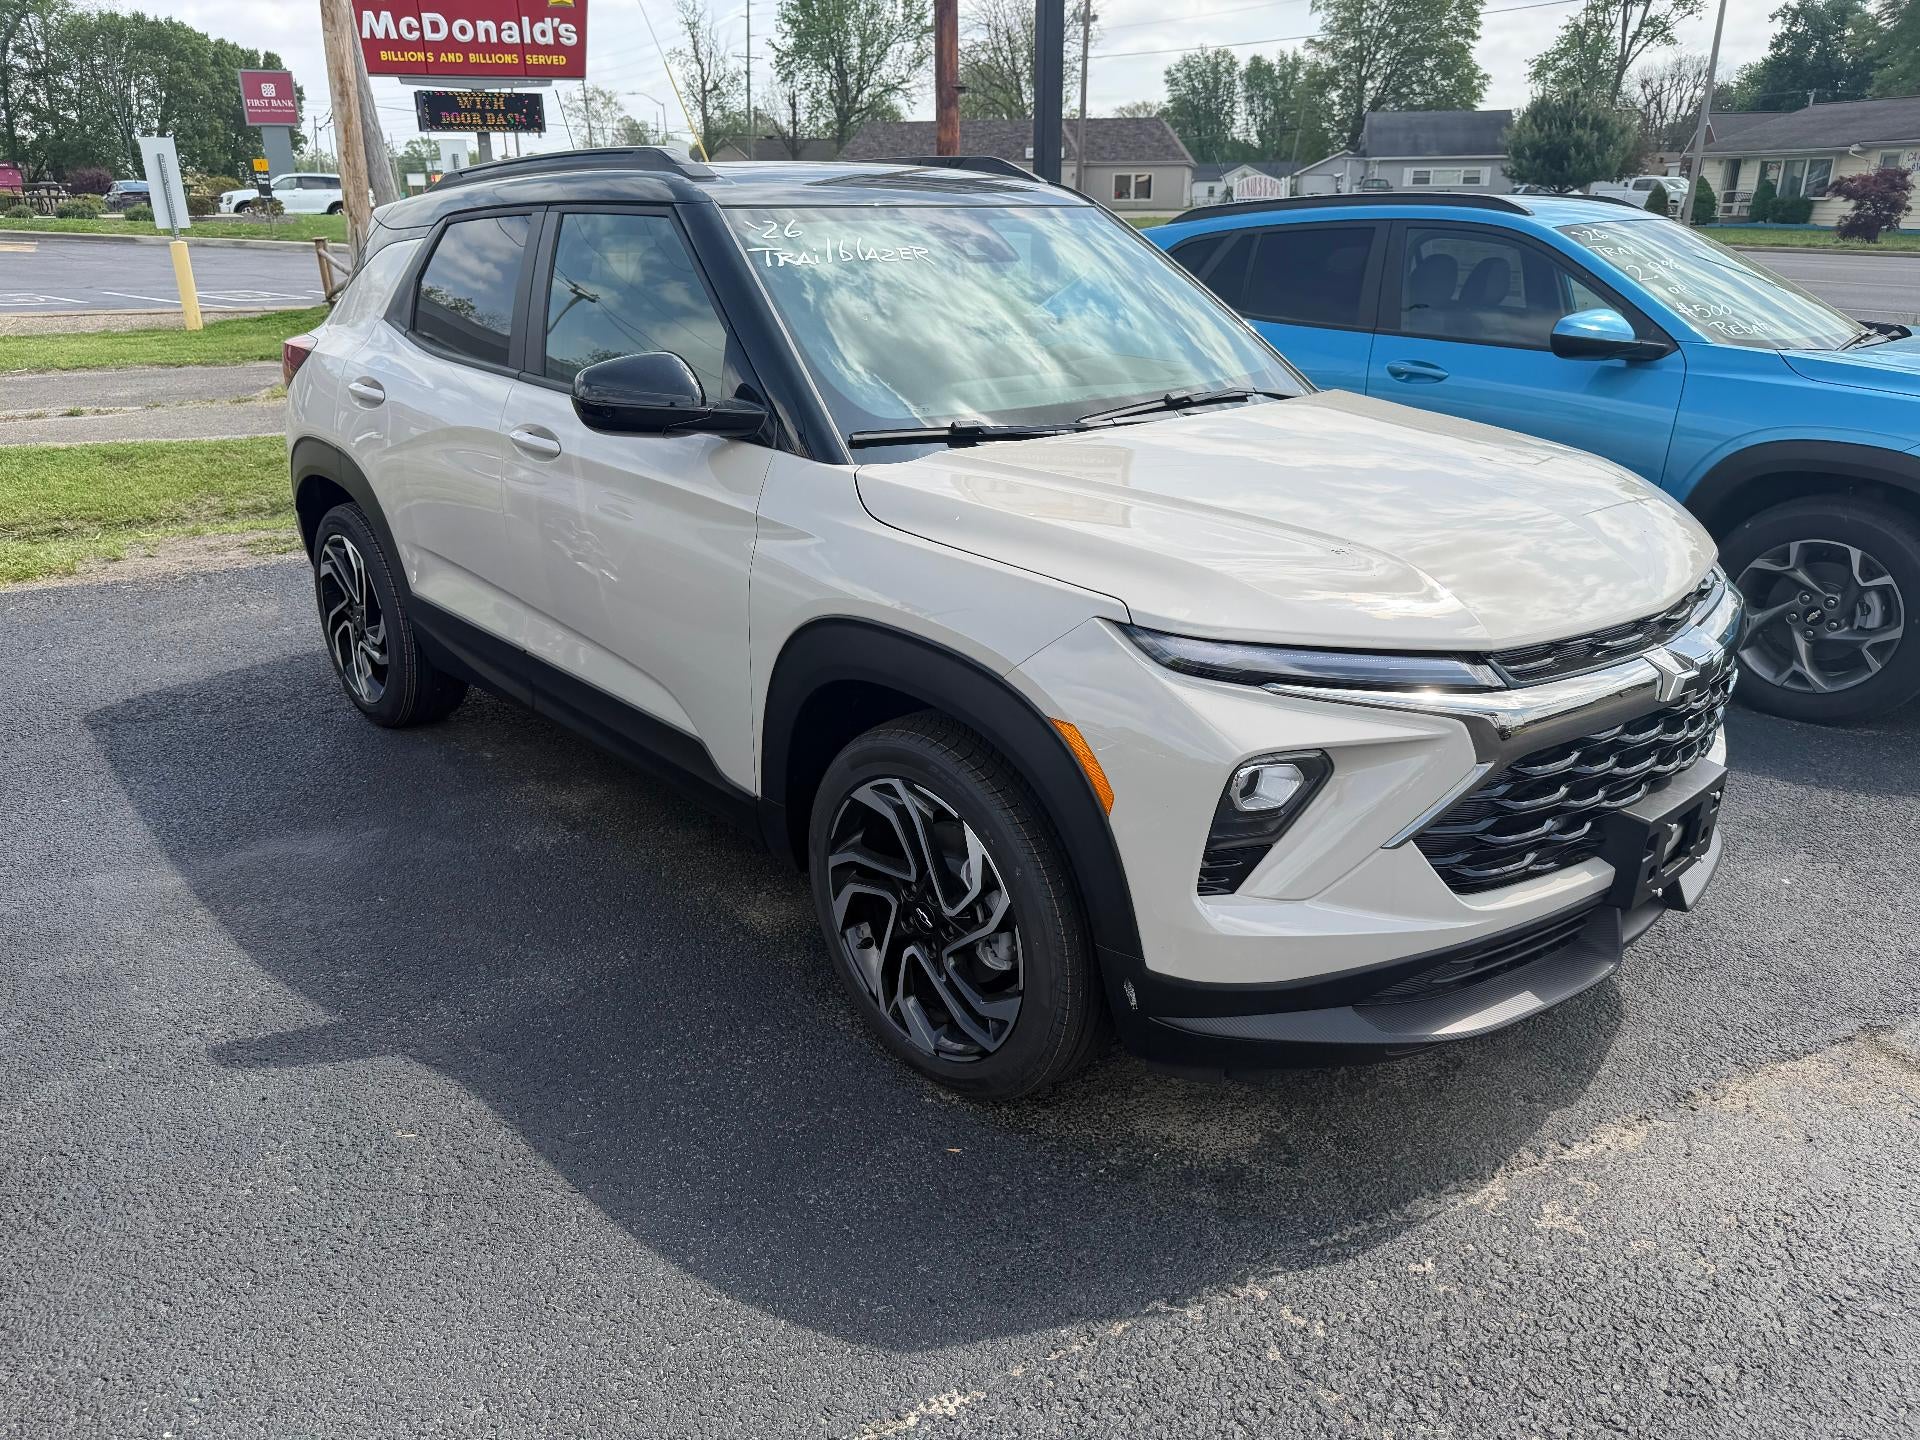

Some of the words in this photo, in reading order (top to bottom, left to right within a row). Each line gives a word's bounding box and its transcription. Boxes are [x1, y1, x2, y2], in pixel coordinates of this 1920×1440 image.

[362, 10, 578, 46] McDonald's
[380, 50, 435, 63] BILLIONS
[439, 52, 464, 64] AND
[469, 53, 519, 65] BILLIONS
[526, 55, 567, 66] SERVED
[246, 98, 270, 107] FIRST
[271, 99, 294, 107] BANK
[457, 97, 505, 110] WITH
[440, 112, 482, 124] DOOR
[1625, 258, 1682, 282] 2.9%
